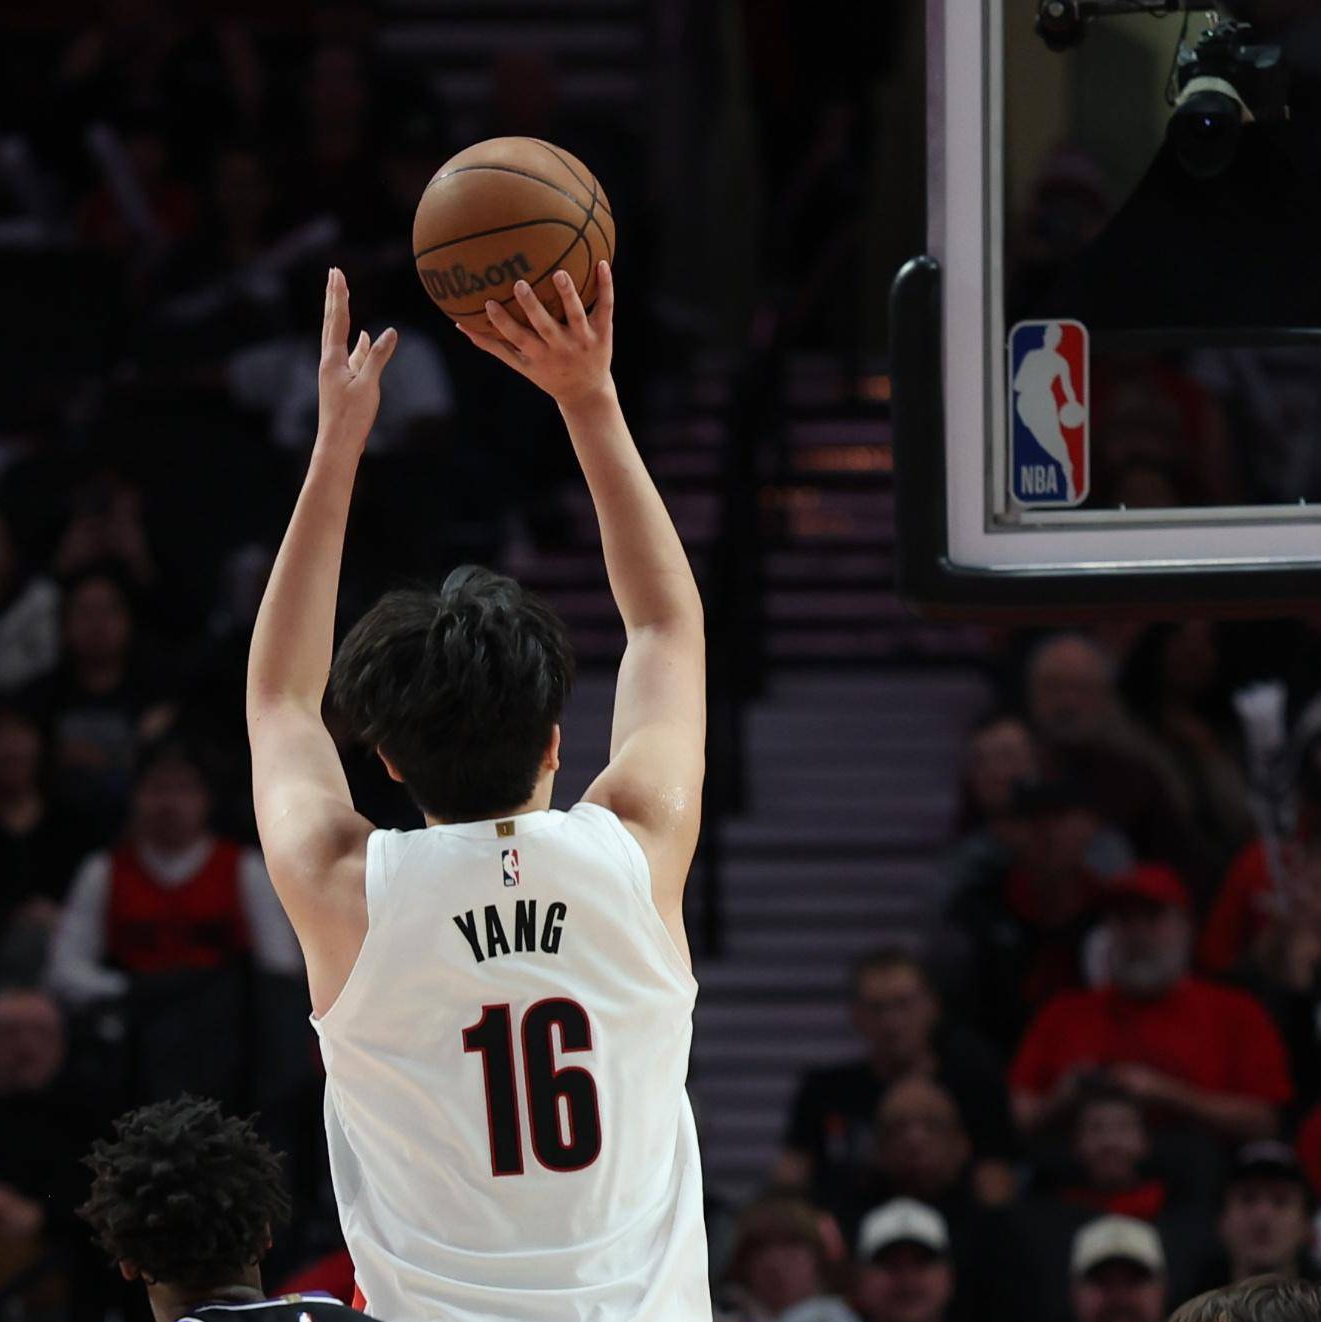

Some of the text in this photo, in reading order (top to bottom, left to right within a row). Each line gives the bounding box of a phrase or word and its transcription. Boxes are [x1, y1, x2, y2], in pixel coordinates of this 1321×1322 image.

[421, 252, 531, 300] Wilson
[1021, 464, 1058, 495] NBA
[452, 899, 567, 963] YANG
[461, 997, 602, 1177] 16
